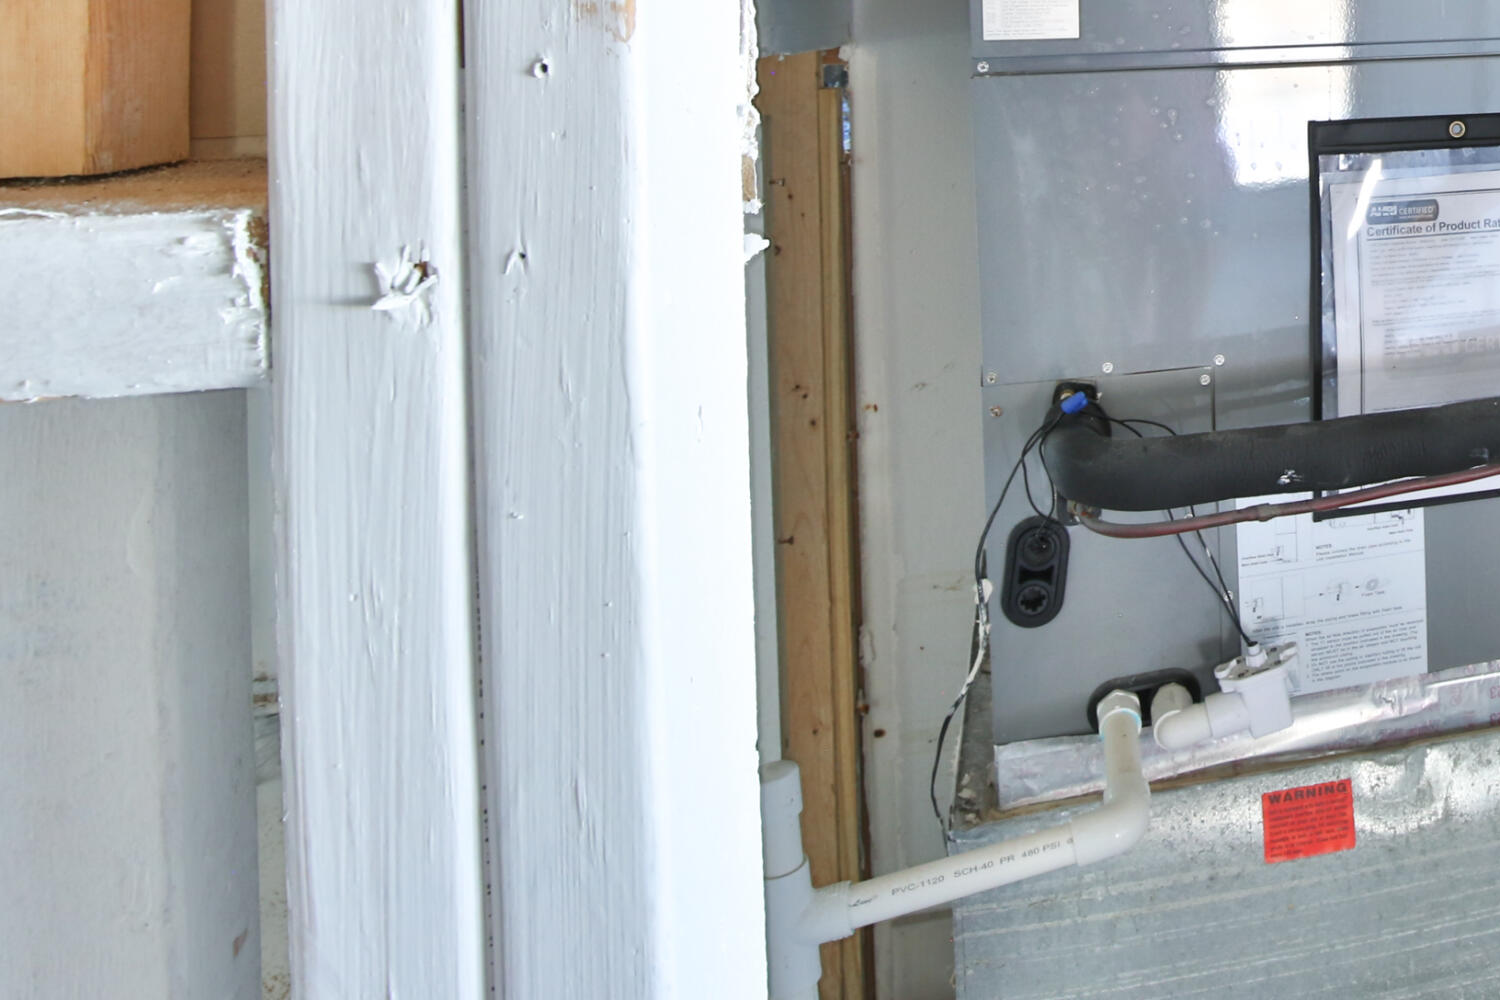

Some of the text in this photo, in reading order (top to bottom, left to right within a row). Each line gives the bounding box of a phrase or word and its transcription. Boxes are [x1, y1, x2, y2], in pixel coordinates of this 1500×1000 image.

[1367, 225, 1422, 237] Certificate
[1426, 222, 1436, 232] of
[1439, 219, 1481, 232] Product
[1268, 782, 1347, 805] WARNING
[891, 841, 1061, 896] PVC-1120 SCH-40 PR 480 PSI
